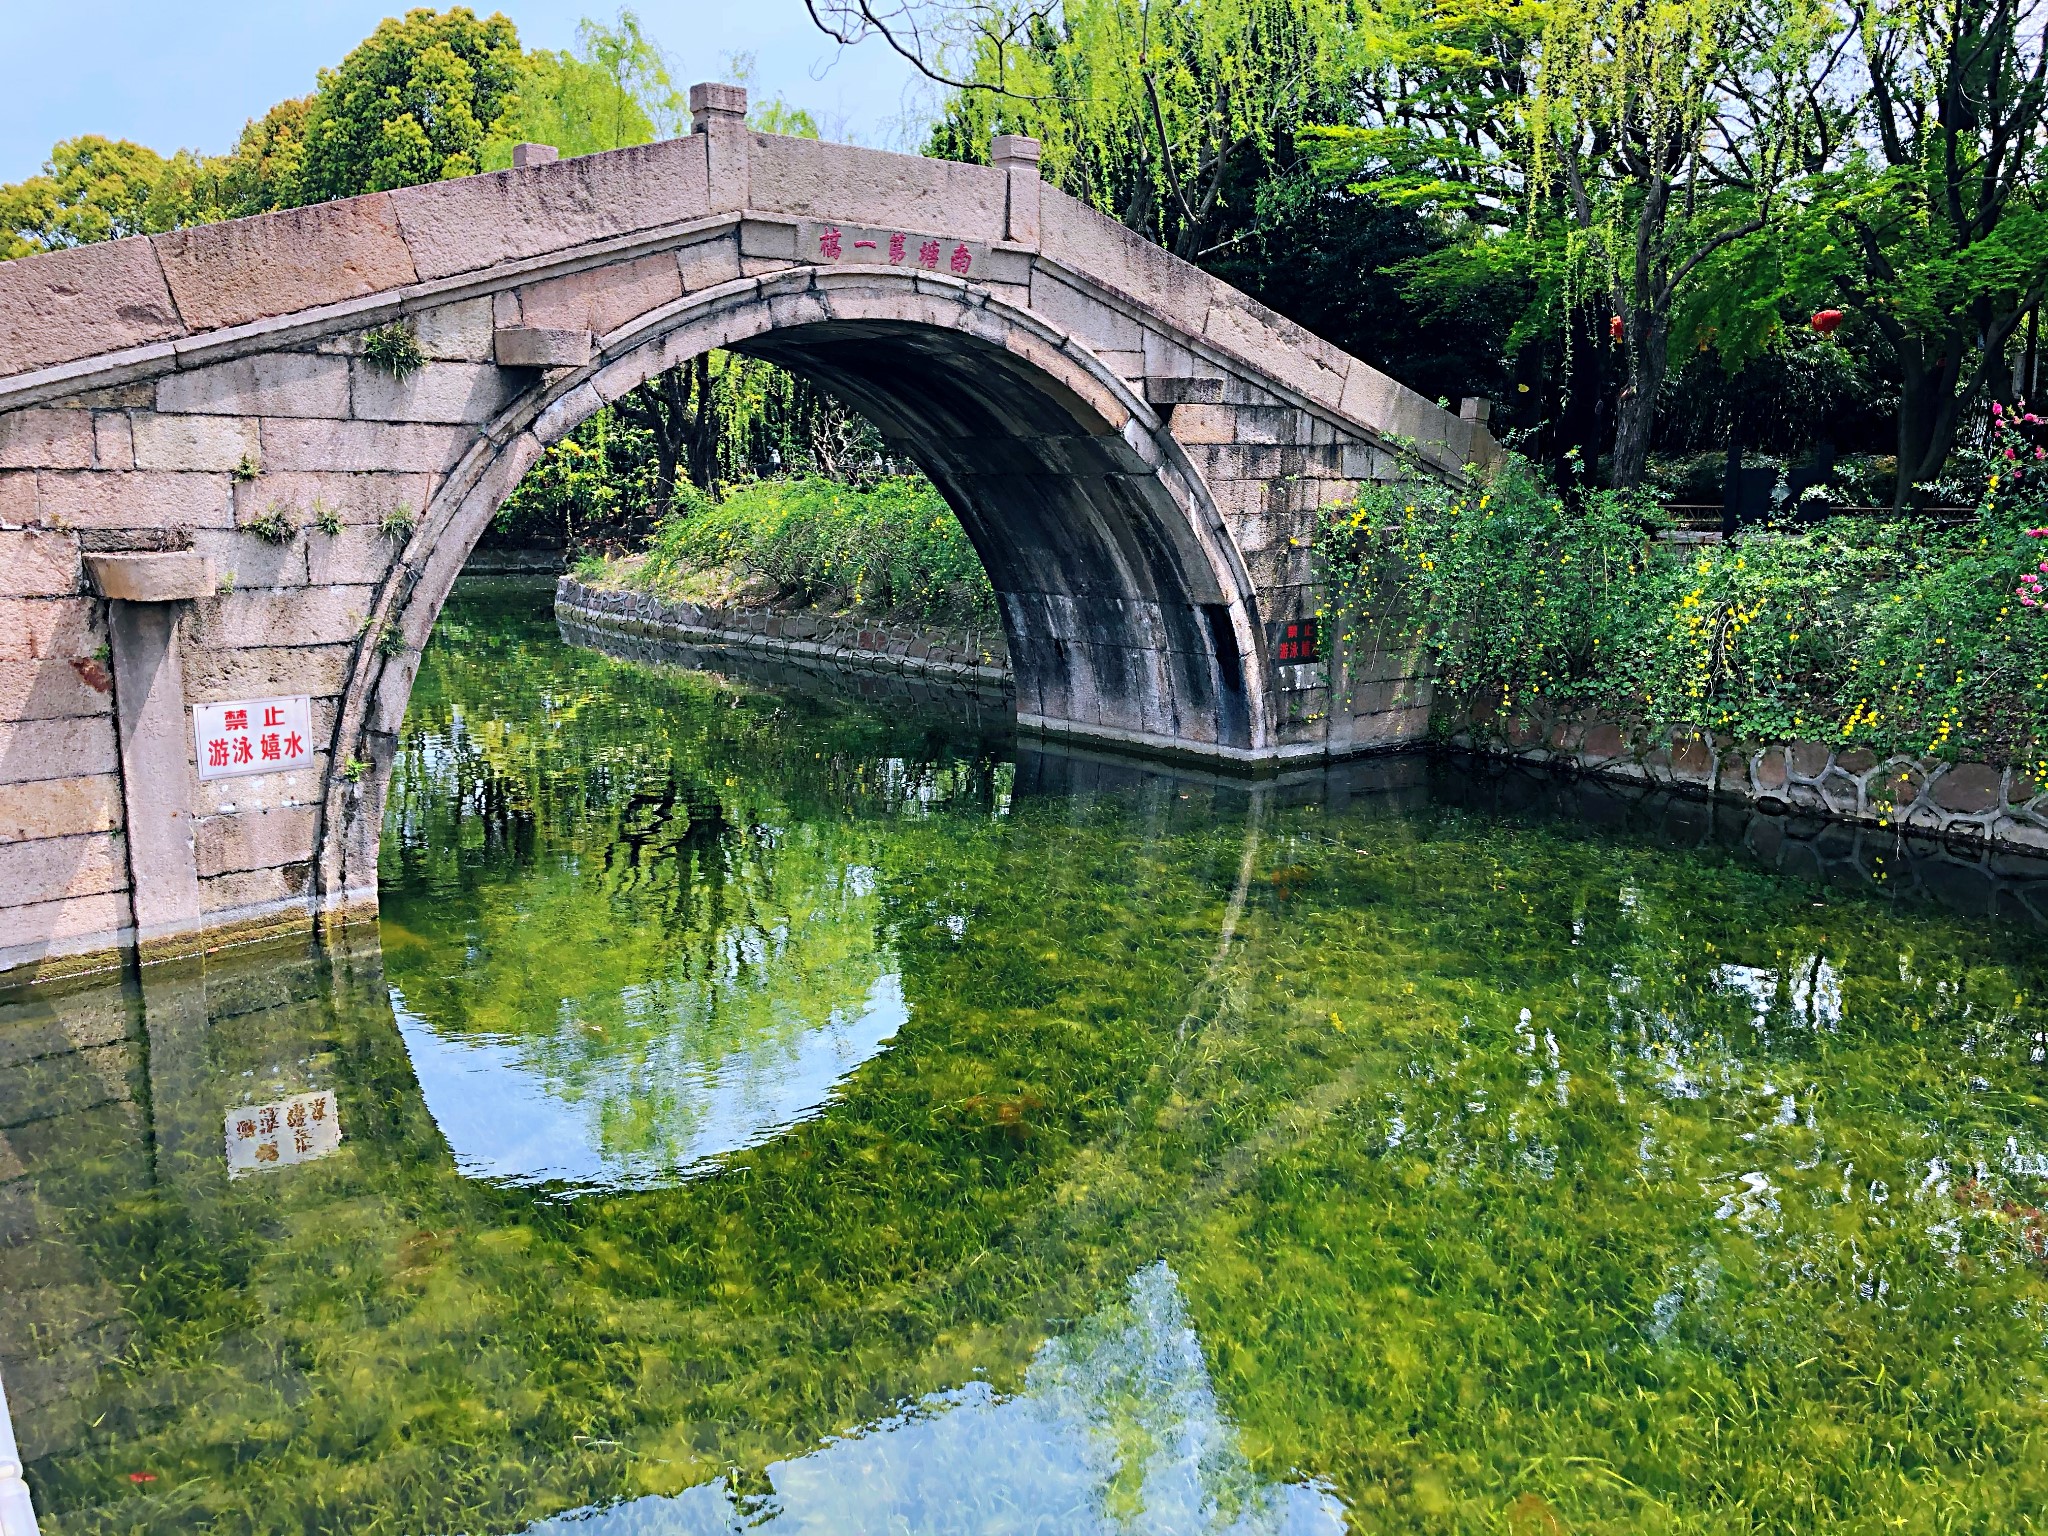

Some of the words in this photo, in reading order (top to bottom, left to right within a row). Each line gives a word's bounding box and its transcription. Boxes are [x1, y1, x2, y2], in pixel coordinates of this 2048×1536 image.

[224, 705, 286, 732] 禁止
[207, 730, 304, 767] 游泳嬉水
